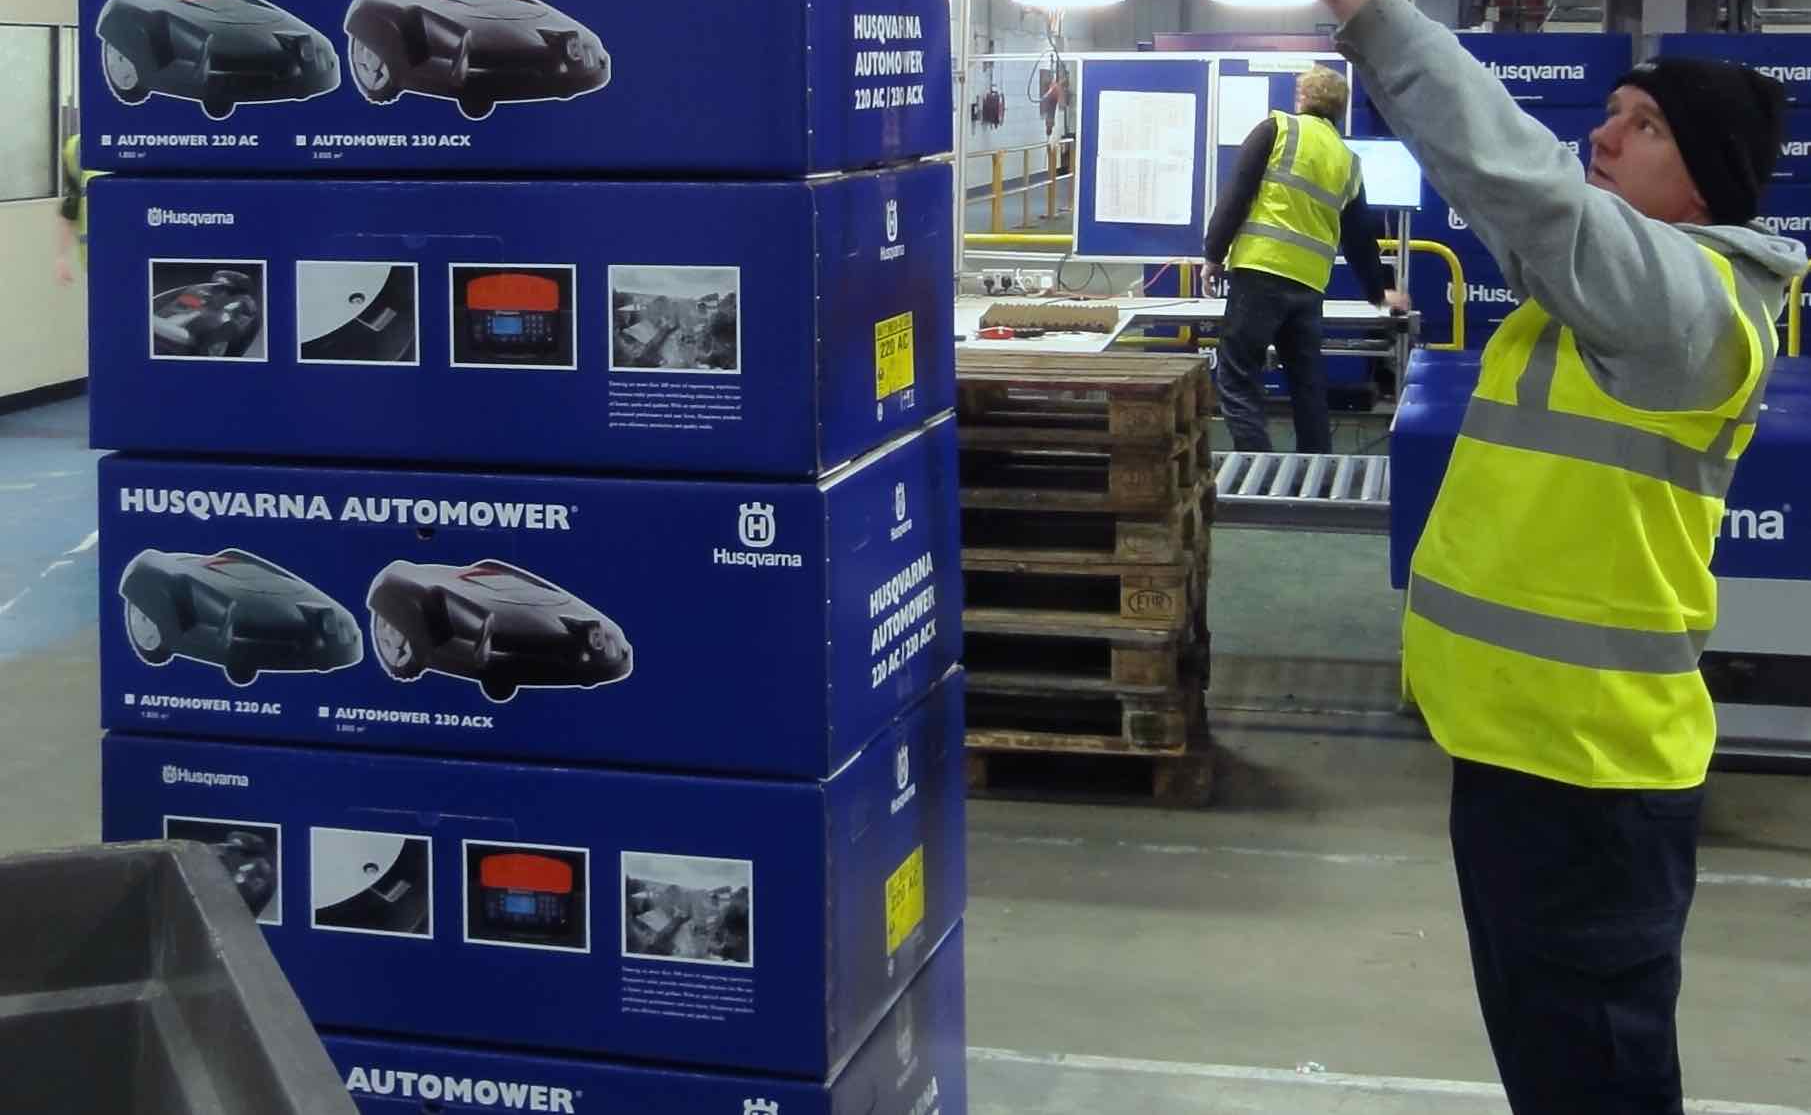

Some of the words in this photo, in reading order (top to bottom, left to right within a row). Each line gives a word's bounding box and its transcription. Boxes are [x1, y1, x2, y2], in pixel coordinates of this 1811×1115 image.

[854, 14, 922, 44] HUSQVARNA
[855, 51, 924, 76] AUTOMOWER
[855, 88, 871, 110] 220
[872, 87, 885, 108] AC
[117, 135, 208, 147] AUTOMOWER
[212, 135, 236, 147] 220
[238, 135, 259, 147] AC
[312, 135, 408, 147] AUTOMOWER
[412, 135, 437, 147] 230
[438, 135, 471, 147] ACX
[162, 209, 234, 226] Husqvarna
[880, 339, 895, 359] 220
[120, 488, 333, 520] HUSQVARNA
[713, 548, 802, 568] Husqvarna
[869, 551, 933, 618] HUSQVARNA
[871, 586, 936, 656] AUTOMOWER
[872, 660, 886, 689] 220
[888, 647, 901, 675] AC
[141, 695, 231, 711] AUTOMOWER
[235, 701, 259, 713] 220
[261, 703, 281, 715] AC
[335, 708, 430, 724] AUTOMOWER
[434, 713, 459, 726] 230
[461, 716, 494, 728] ACX
[177, 768, 248, 786] Husqvarna
